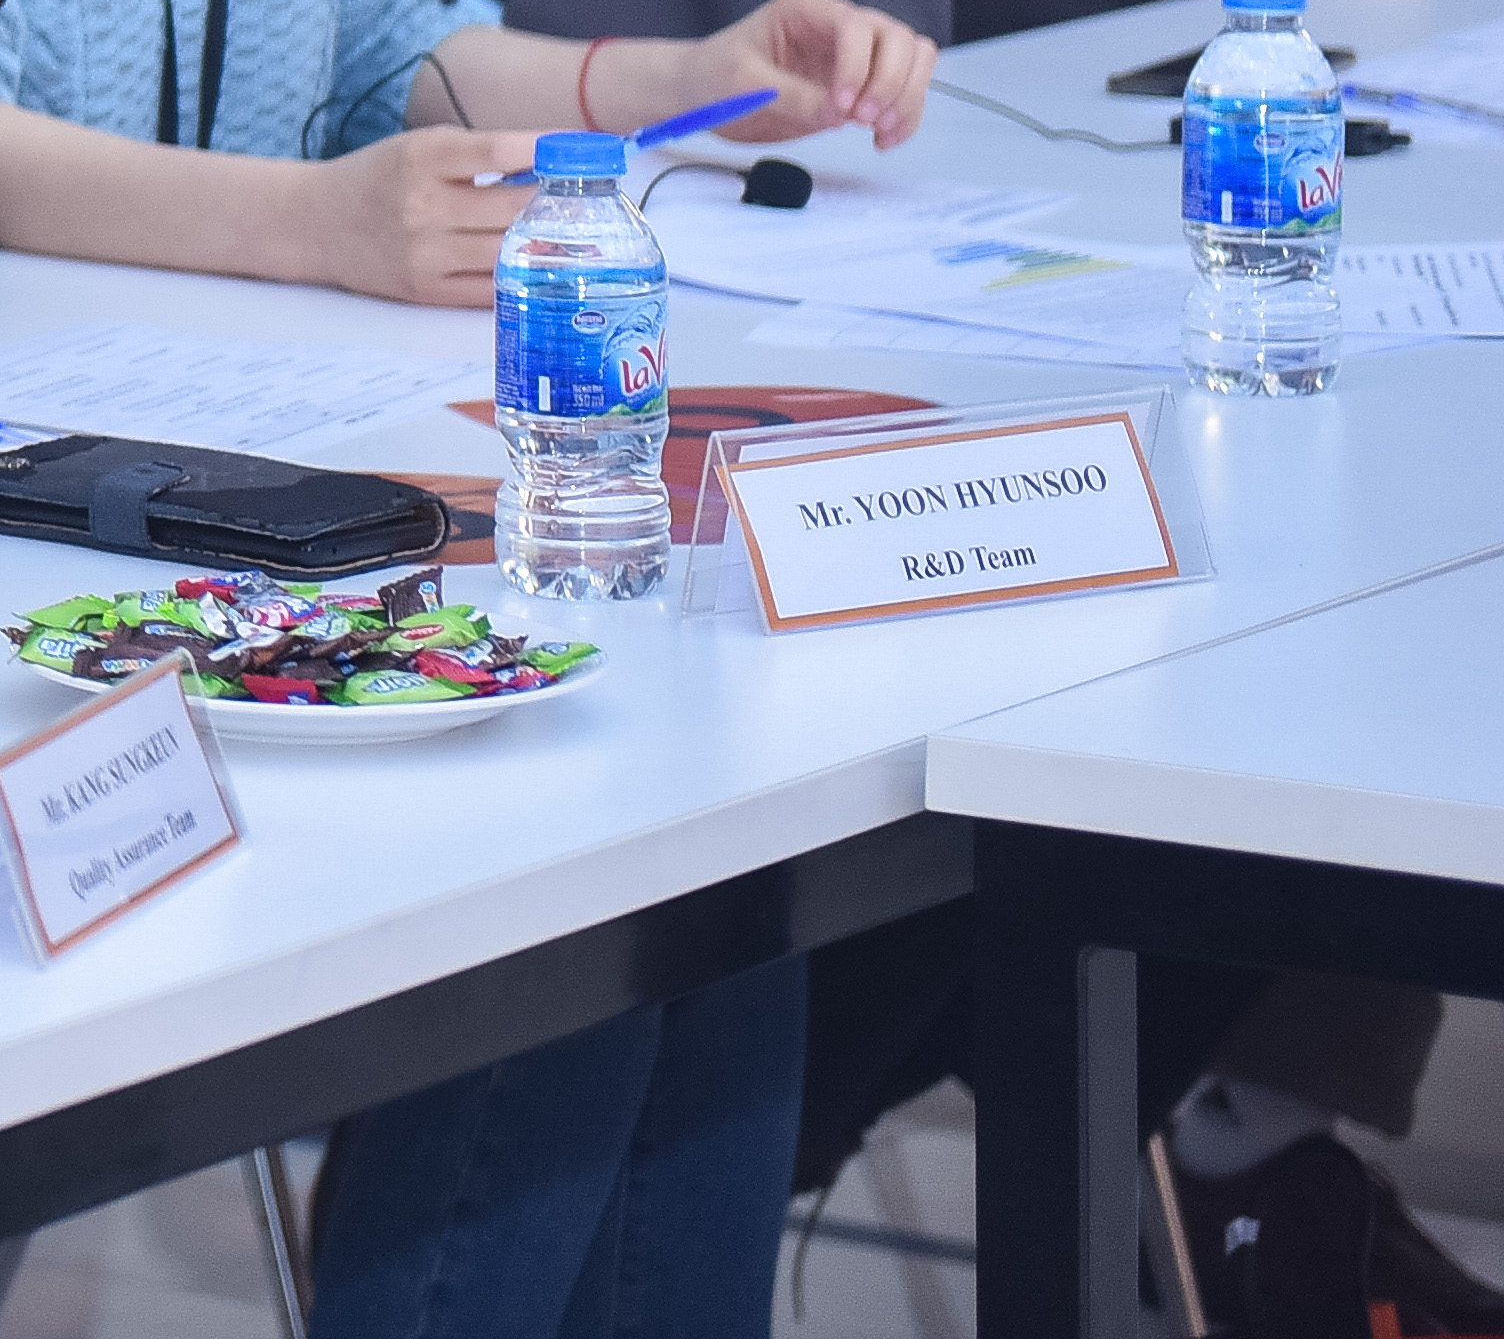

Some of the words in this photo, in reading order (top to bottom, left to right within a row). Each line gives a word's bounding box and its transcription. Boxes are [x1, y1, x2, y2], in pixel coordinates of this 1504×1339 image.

[797, 500, 852, 531] Mr.
[853, 484, 948, 522] YOON
[953, 463, 1108, 510] HYUNSOO
[901, 549, 965, 582] R&D
[969, 544, 1038, 572] Team
[163, 809, 198, 840] Team
